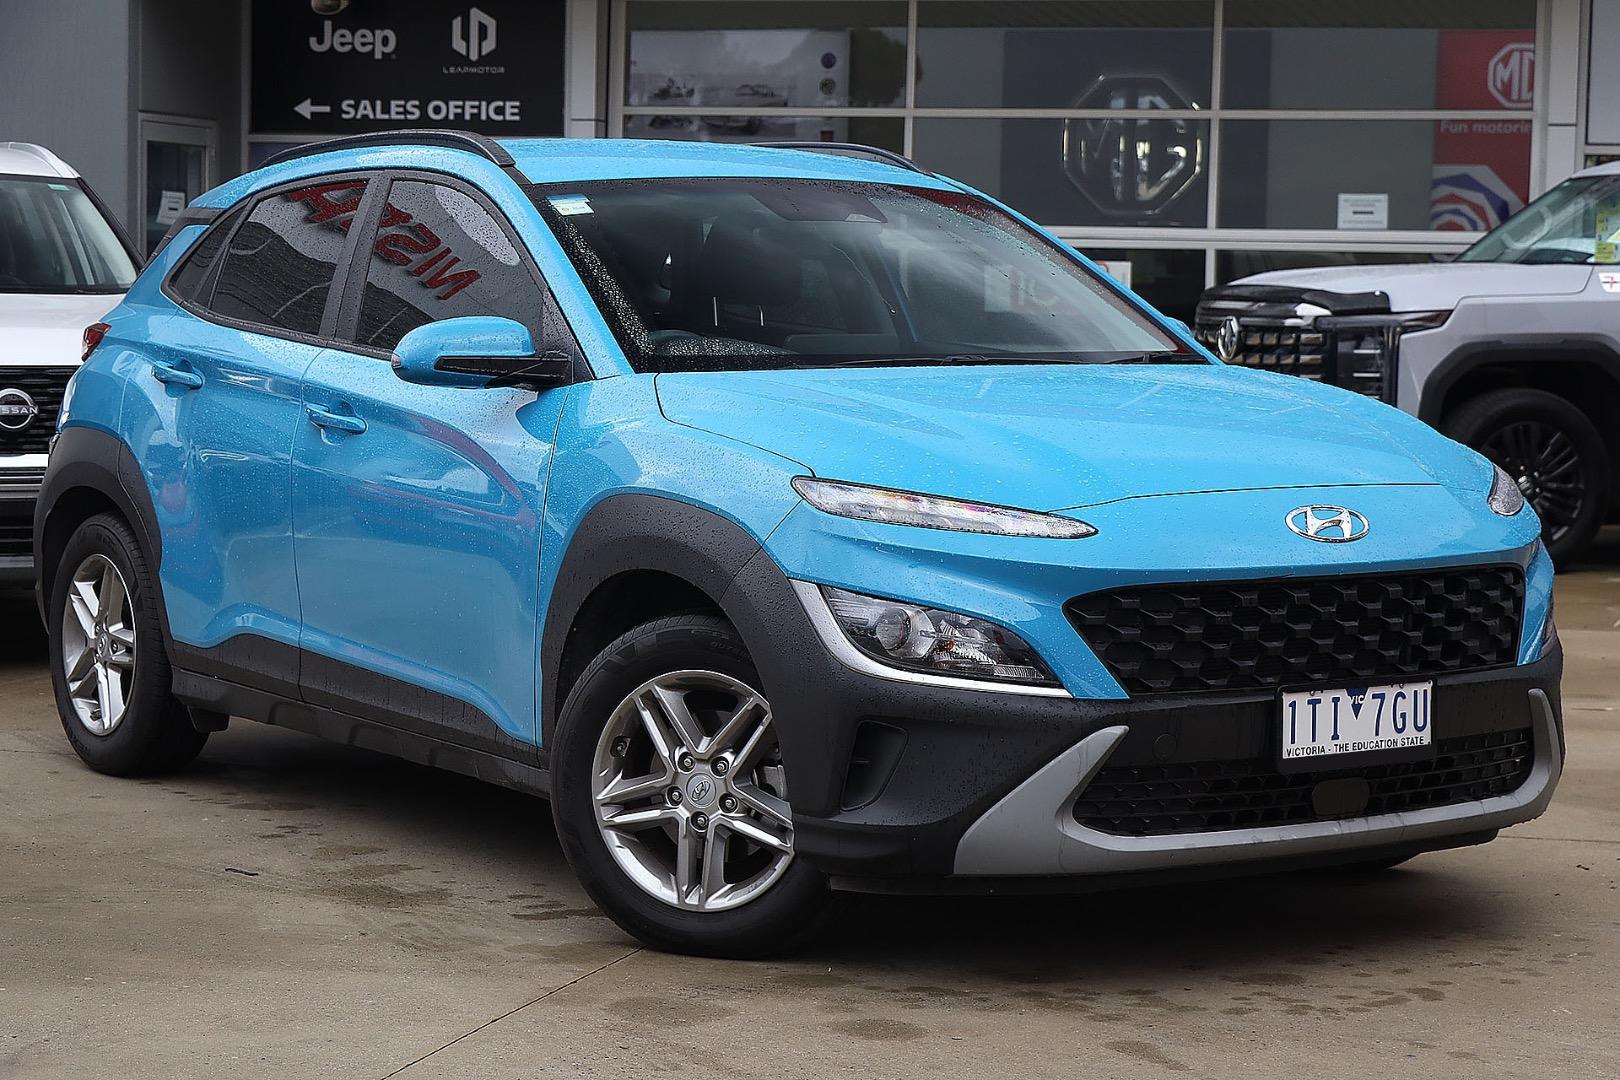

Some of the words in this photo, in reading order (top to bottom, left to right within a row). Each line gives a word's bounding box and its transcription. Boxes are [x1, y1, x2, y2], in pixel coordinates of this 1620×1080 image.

[309, 20, 397, 59] Jeep
[340, 99, 421, 120] SALES
[427, 100, 521, 121] OFFICE
[1440, 119, 1468, 133] Fun
[0, 404, 38, 415] SSAN
[1286, 745, 1326, 758] VICTORIA
[1334, 742, 1350, 753] THE
[1352, 738, 1398, 752] EDUCATION
[1400, 735, 1425, 747] STATE
